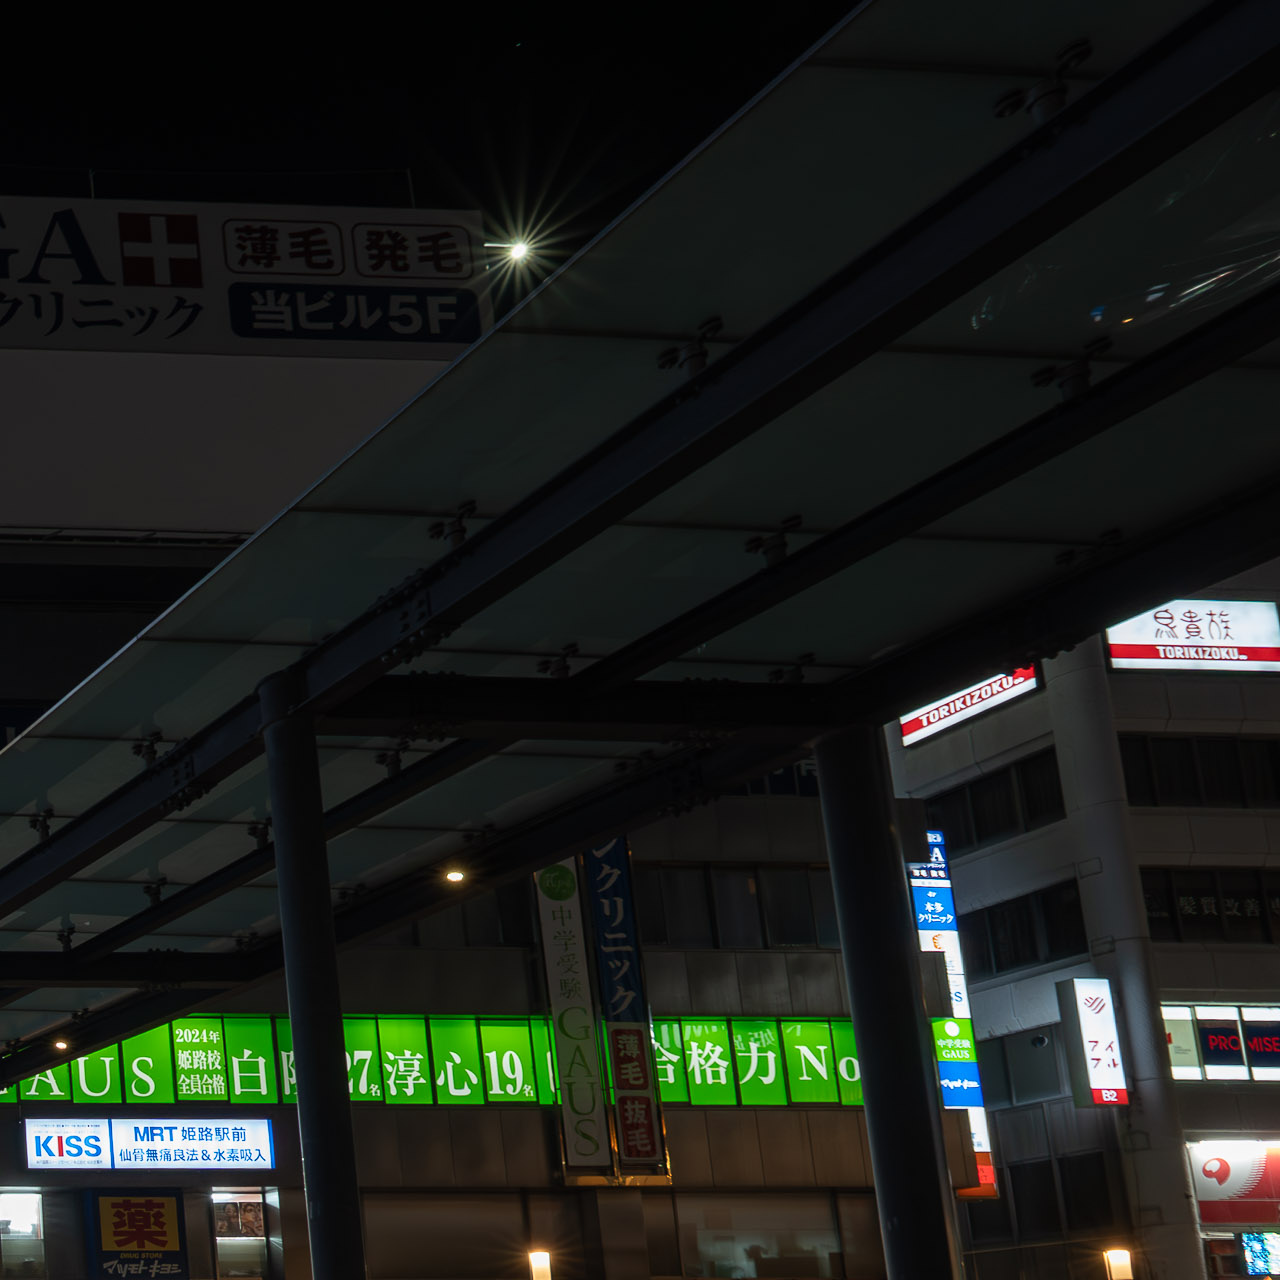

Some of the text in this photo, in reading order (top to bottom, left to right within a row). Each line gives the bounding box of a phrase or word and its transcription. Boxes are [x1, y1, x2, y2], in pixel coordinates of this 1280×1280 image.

[234, 225, 334, 269] 薄毛
[367, 229, 462, 274] 発毛
[251, 290, 457, 335] 当ビル5F
[1156, 646, 1239, 661] TORIKIZOKU
[550, 904, 582, 1000] 中学受験
[175, 1028, 220, 1044] 2024年
[177, 1049, 222, 1071] 姫路校
[616, 1029, 645, 1086] 薄毛
[942, 1050, 971, 1059] GAUS
[177, 1073, 225, 1095] 全員合格
[557, 1007, 600, 1157] GAUS
[1101, 1089, 1119, 1102] B2
[133, 1126, 247, 1143] MRT 姫路駅前
[623, 1098, 652, 1153] 抜毛
[34, 1135, 102, 1158] KISS
[111, 1199, 169, 1249] 薬
